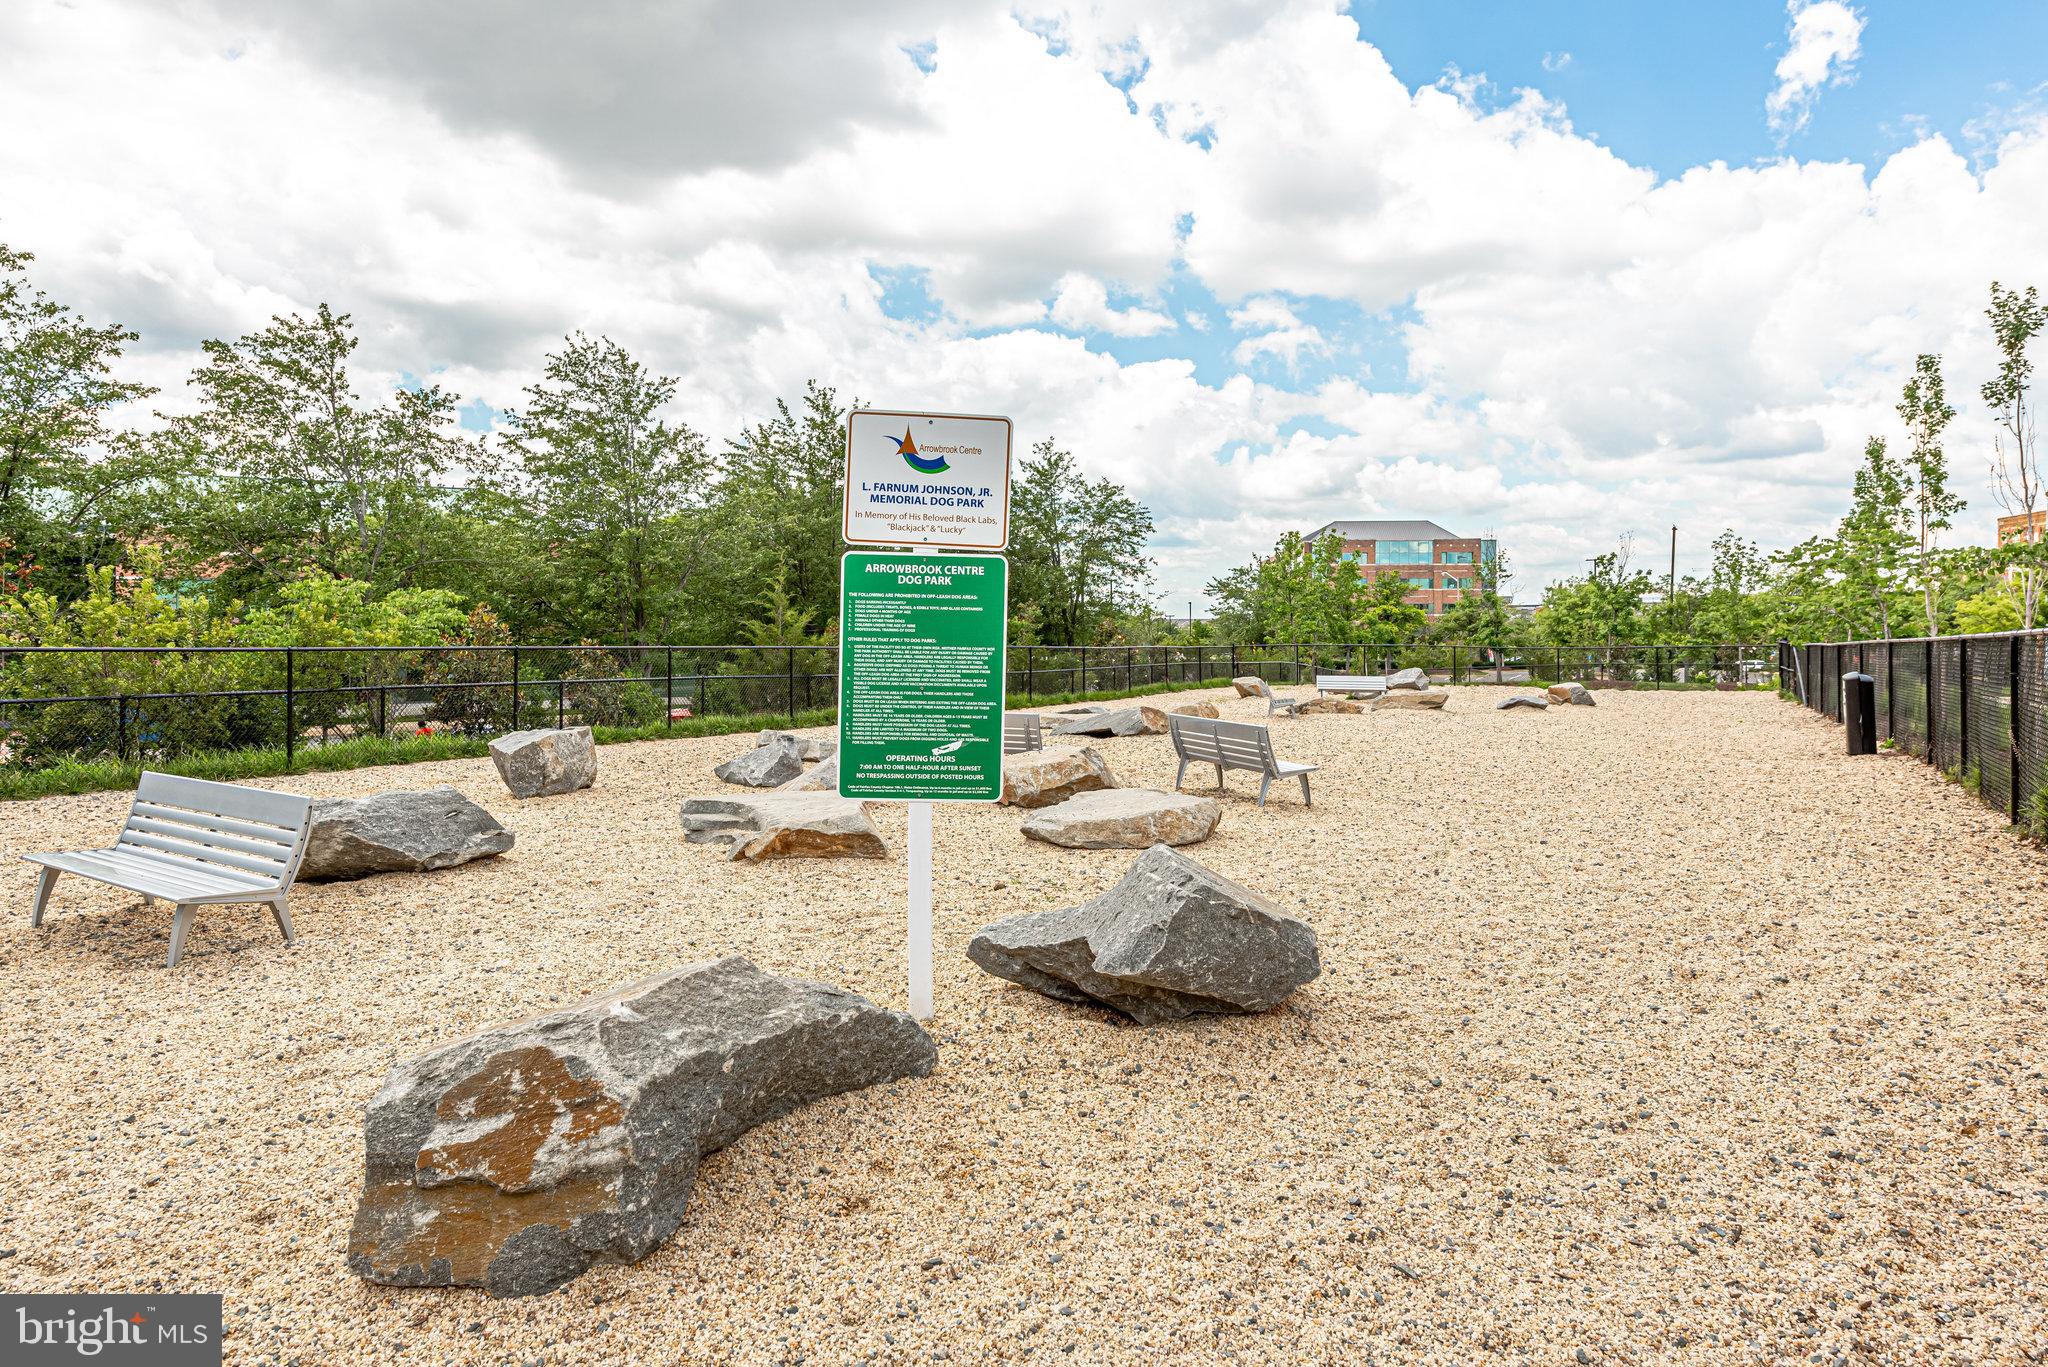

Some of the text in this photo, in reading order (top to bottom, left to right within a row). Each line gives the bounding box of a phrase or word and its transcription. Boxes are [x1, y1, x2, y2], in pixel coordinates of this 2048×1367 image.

[919, 444, 982, 455] Arrowbrook Centre
[862, 483, 992, 497] L. FARNUM JOHNSON, JR.
[870, 494, 984, 508] MEMORIAL DOG PARK
[864, 511, 896, 521] Memory
[923, 514, 954, 522] Beloved
[956, 515, 976, 523] Black
[978, 516, 997, 525] Labs,
[887, 523, 929, 533] "Blackjack"
[937, 526, 966, 535] "Lucky"
[865, 564, 985, 576] ARROWBROOK CENTRE
[897, 575, 952, 585] DOG PARK
